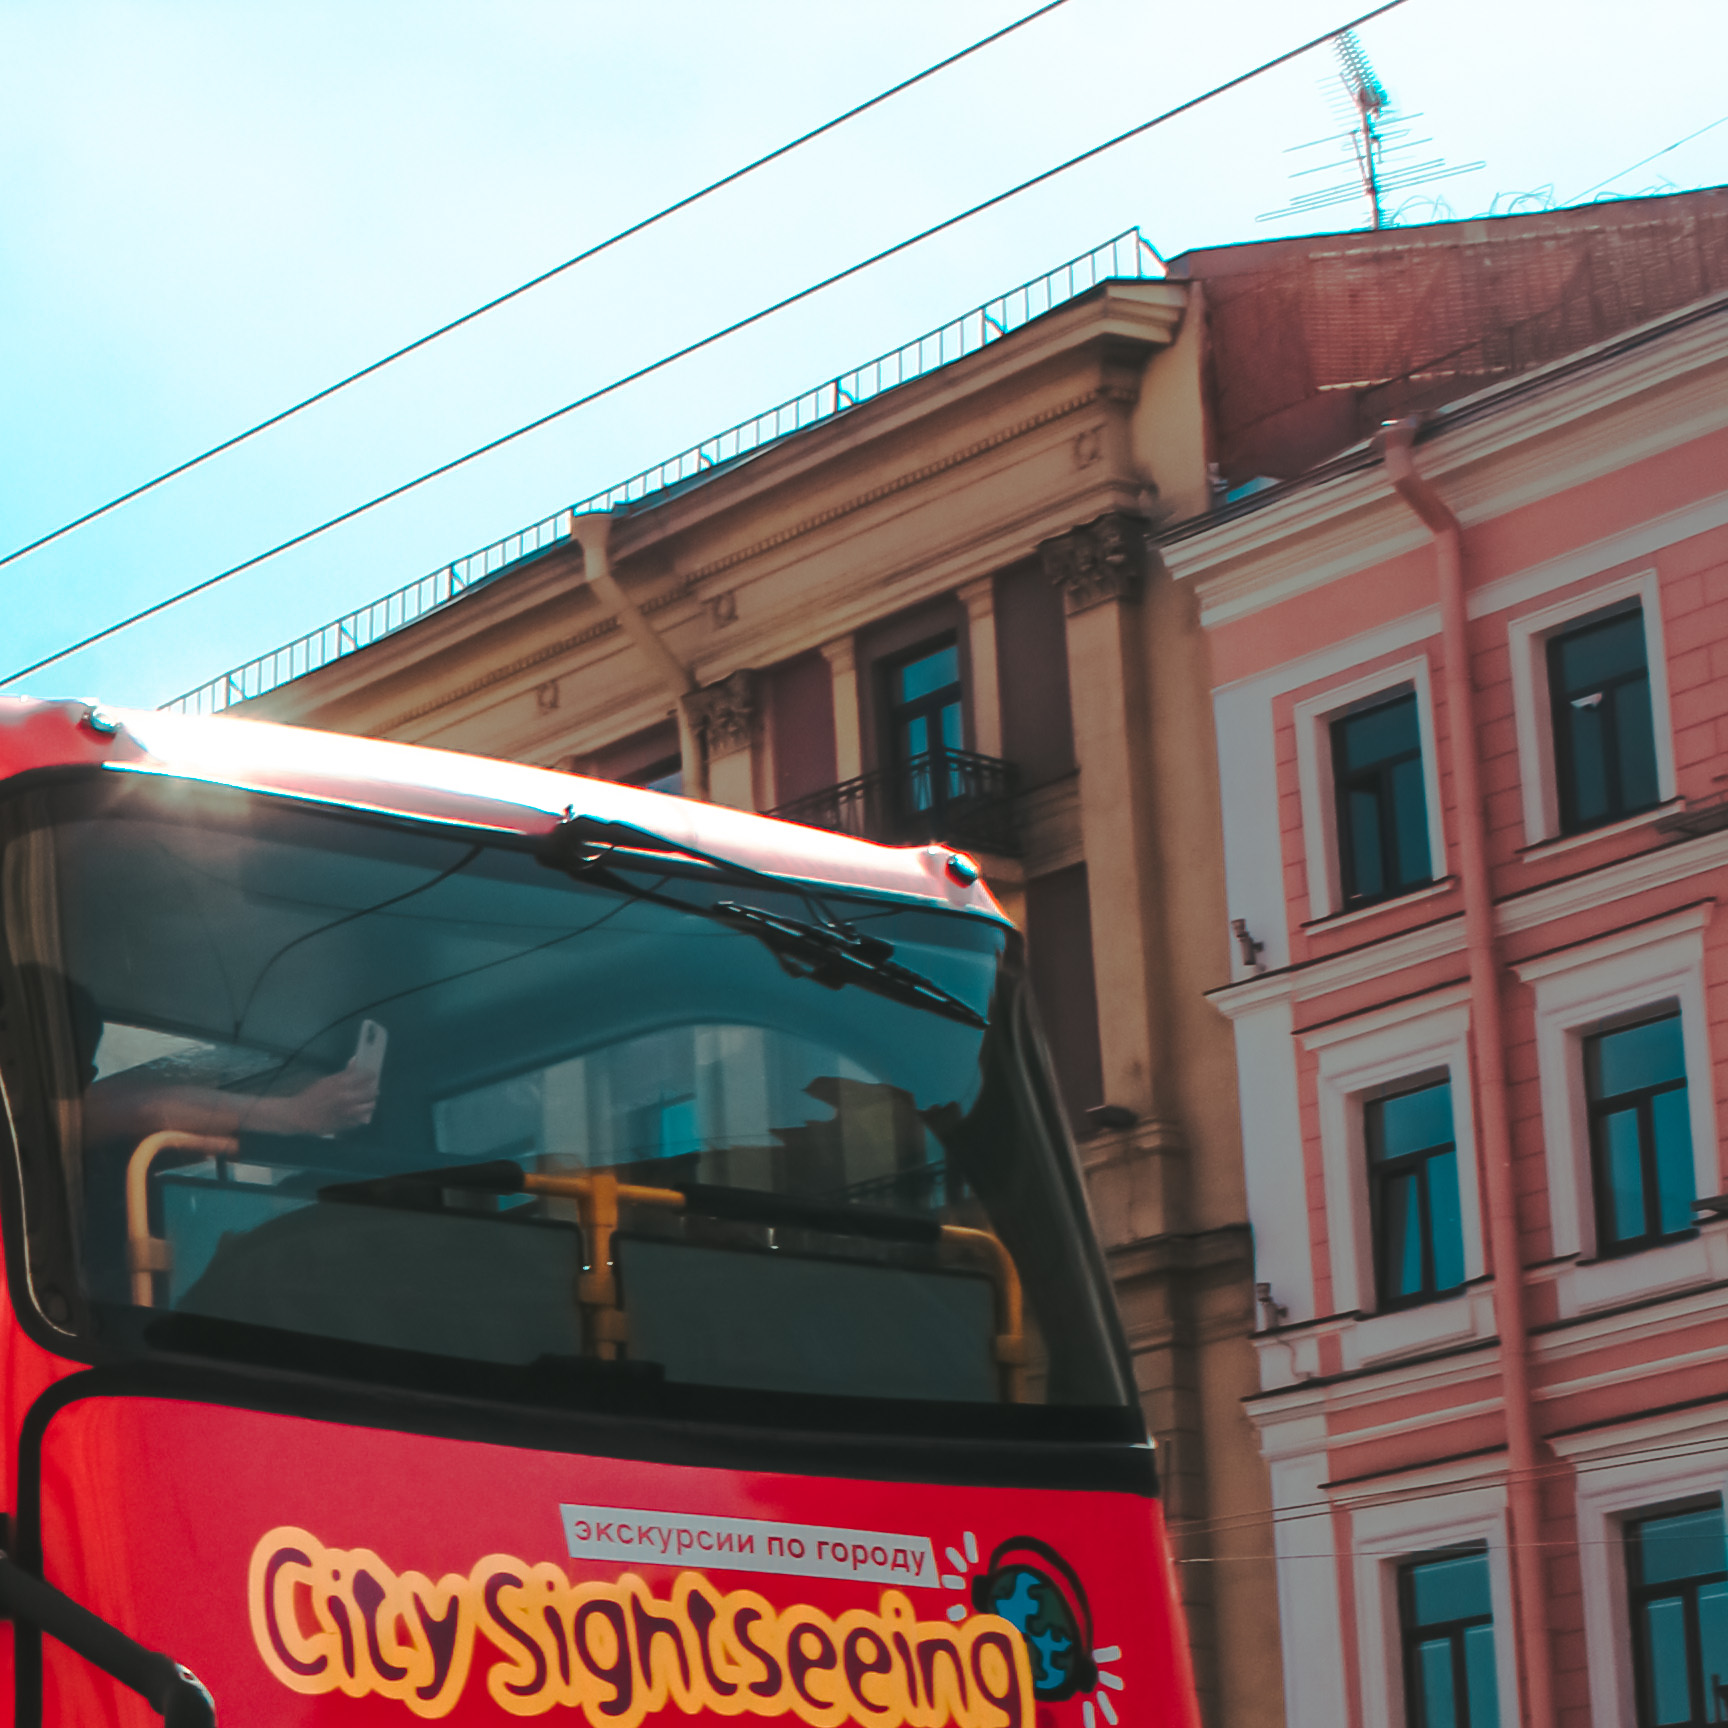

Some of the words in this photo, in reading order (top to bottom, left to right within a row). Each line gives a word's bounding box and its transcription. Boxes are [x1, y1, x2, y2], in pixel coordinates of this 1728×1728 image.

[573, 1516, 756, 1557] экскурсии
[766, 1533, 806, 1561] по
[816, 1538, 928, 1578] городу
